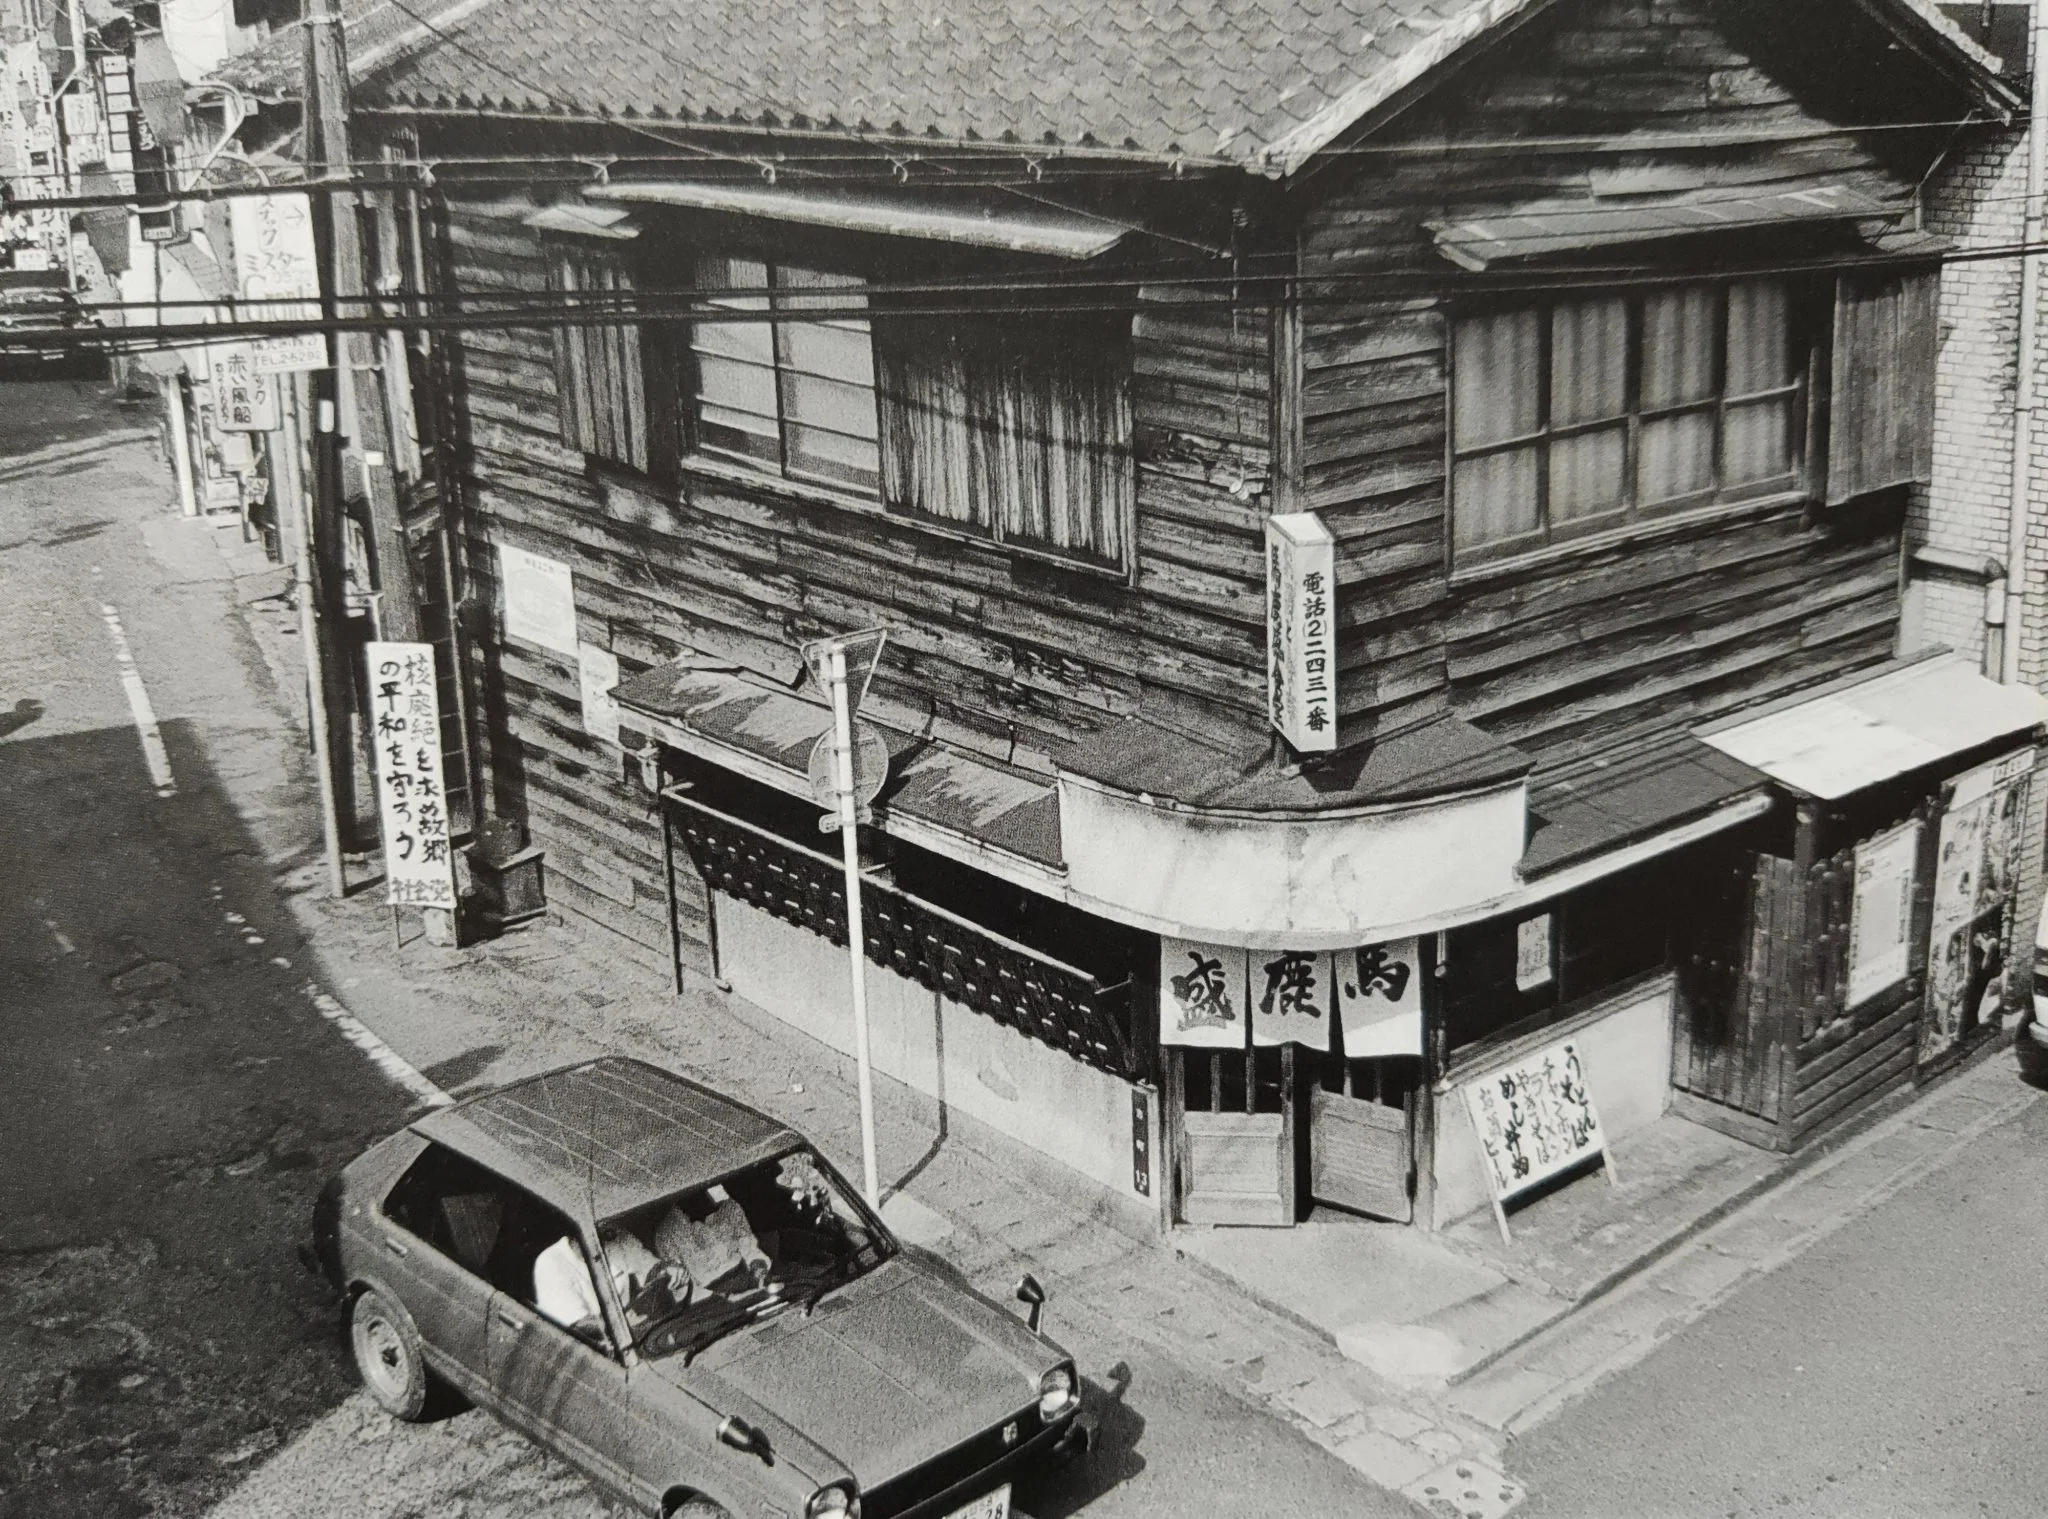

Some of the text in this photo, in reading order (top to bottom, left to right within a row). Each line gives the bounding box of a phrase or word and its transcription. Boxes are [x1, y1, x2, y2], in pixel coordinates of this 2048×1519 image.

[227, 353, 252, 424] 赤い風船
[377, 659, 415, 860] の平和を守ろう
[392, 876, 450, 902] 社会党
